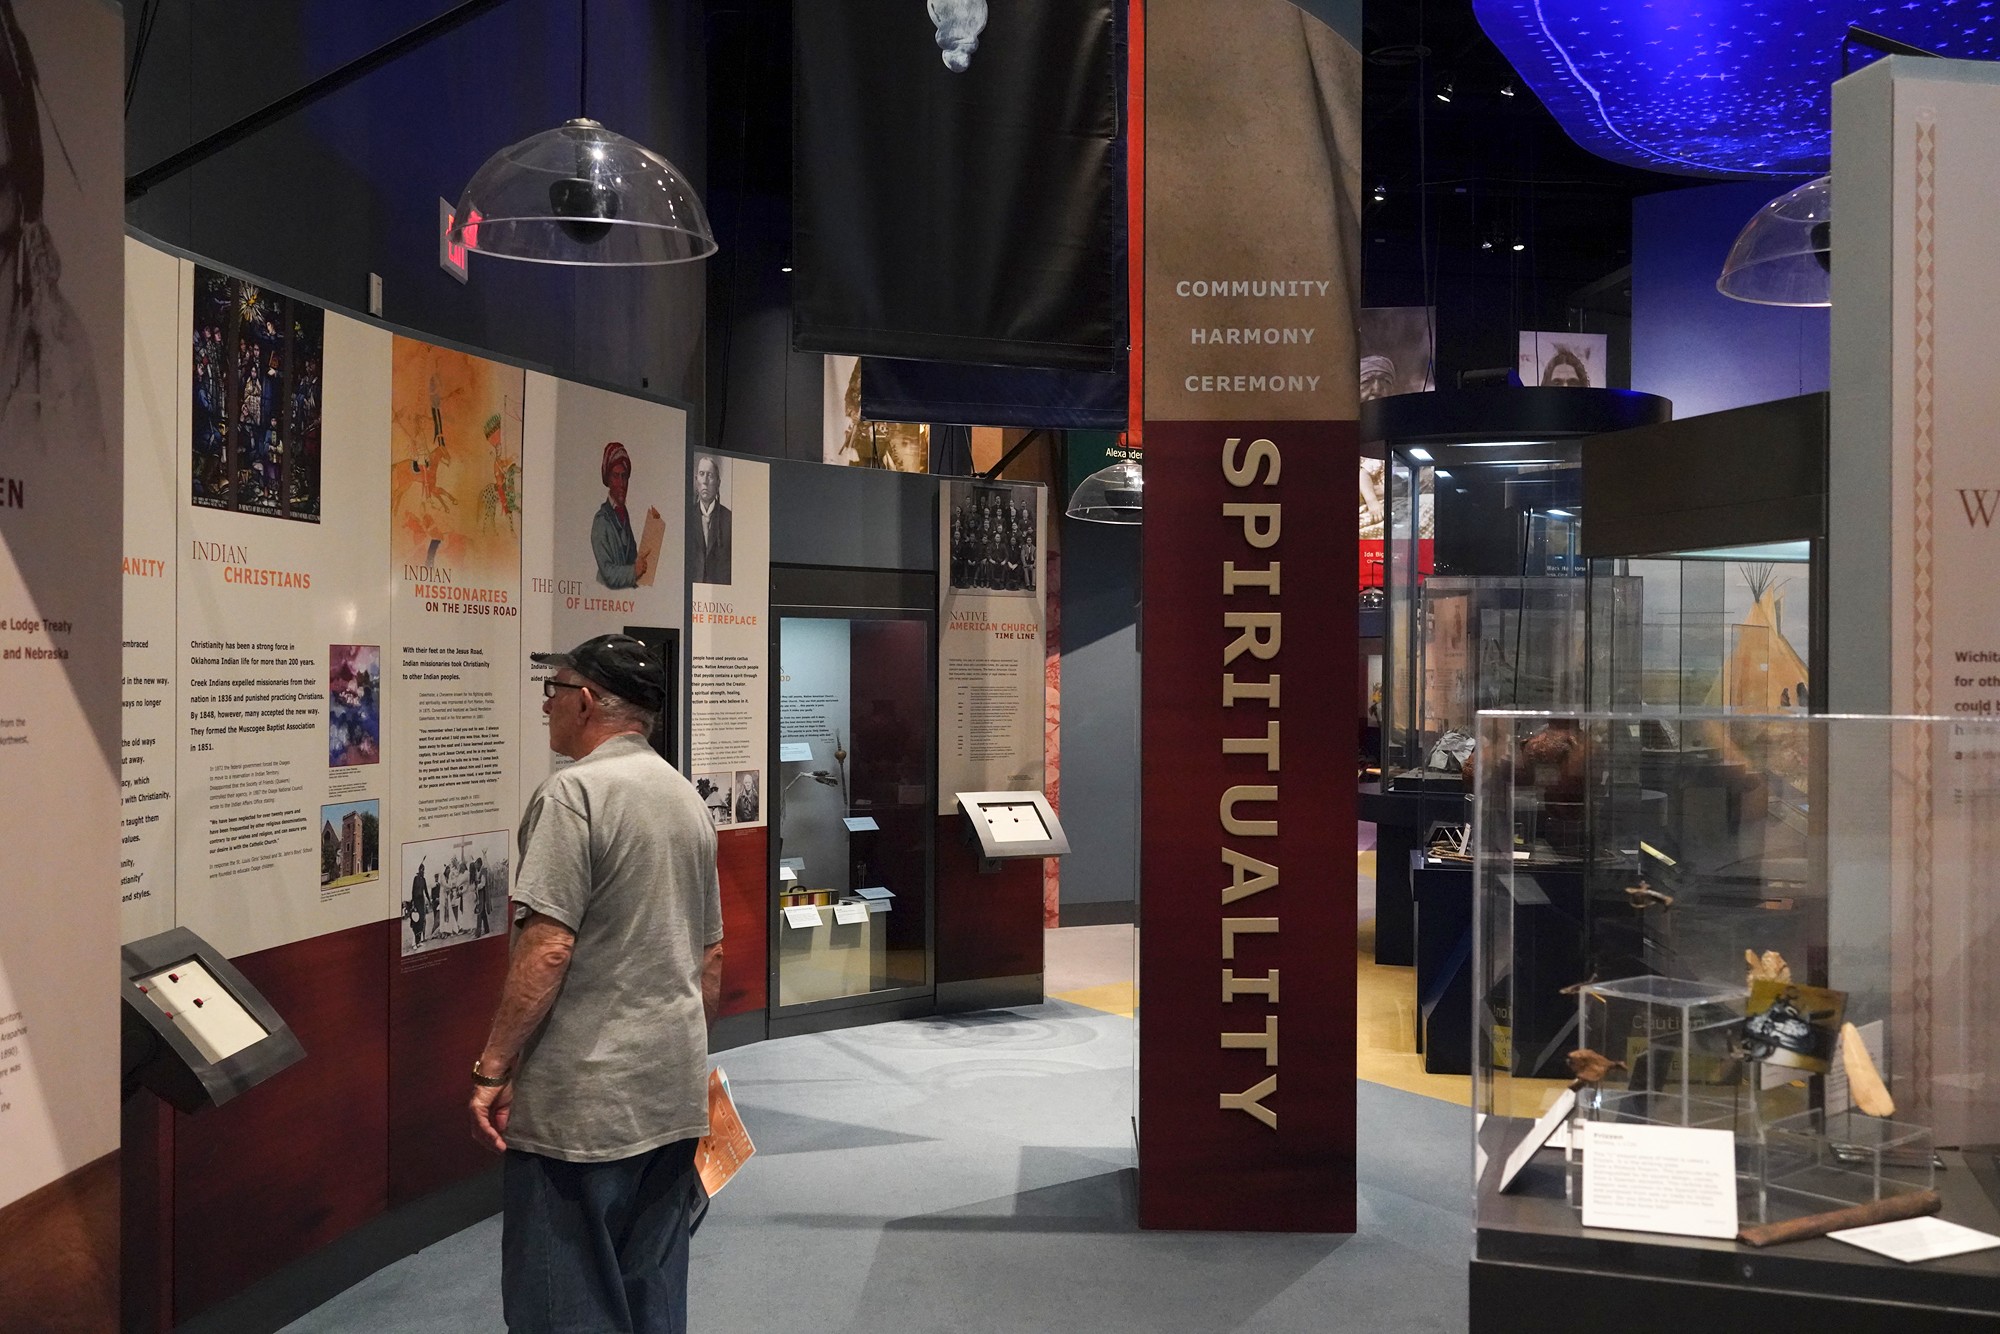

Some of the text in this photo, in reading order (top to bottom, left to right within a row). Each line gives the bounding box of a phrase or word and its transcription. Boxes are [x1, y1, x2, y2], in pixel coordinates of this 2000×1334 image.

[1176, 280, 1330, 297] COMMUNITY
[1191, 328, 1316, 344] HARMONY
[1185, 376, 1320, 392] CEREMONY
[192, 540, 248, 564] INDIAN
[224, 566, 311, 588] CHRISTIANS
[404, 565, 452, 583] INDIAN
[532, 578, 582, 595] THE GIFT
[415, 584, 508, 603] MISSIONARIES
[426, 602, 517, 616] ON THE JESUS ROAD
[566, 597, 635, 612] OF LITERACY
[708, 614, 756, 625] FIREPLACE
[950, 612, 988, 621] NATIVE
[10, 618, 72, 634] Lodge Treaty
[950, 622, 1038, 632] AMERICAN CHURCH
[122, 640, 148, 648] embraced
[191, 641, 224, 650] Christianity
[256, 643, 274, 651] strong
[4, 646, 69, 659] and Nebraska
[232, 679, 255, 688] expelled
[1954, 676, 1974, 686] for
[144, 699, 162, 708] longer
[190, 695, 209, 703] nation
[246, 694, 269, 702] punished
[270, 694, 296, 702] practicing
[190, 712, 198, 720] By
[200, 711, 216, 720] 1848,
[218, 710, 243, 718] however,
[261, 709, 284, 718] accepted
[190, 728, 204, 736] They
[206, 726, 226, 734] formed
[238, 726, 265, 734] Muscogee
[266, 724, 285, 732] Baptist
[132, 738, 140, 746] old
[142, 738, 156, 746] ways
[134, 776, 150, 785] which
[1219, 437, 1282, 1130] SPIRITUALITY
[138, 792, 171, 802] Christianity.
[126, 816, 144, 826] taught
[122, 835, 140, 844] values.
[122, 890, 151, 902] and styles.
